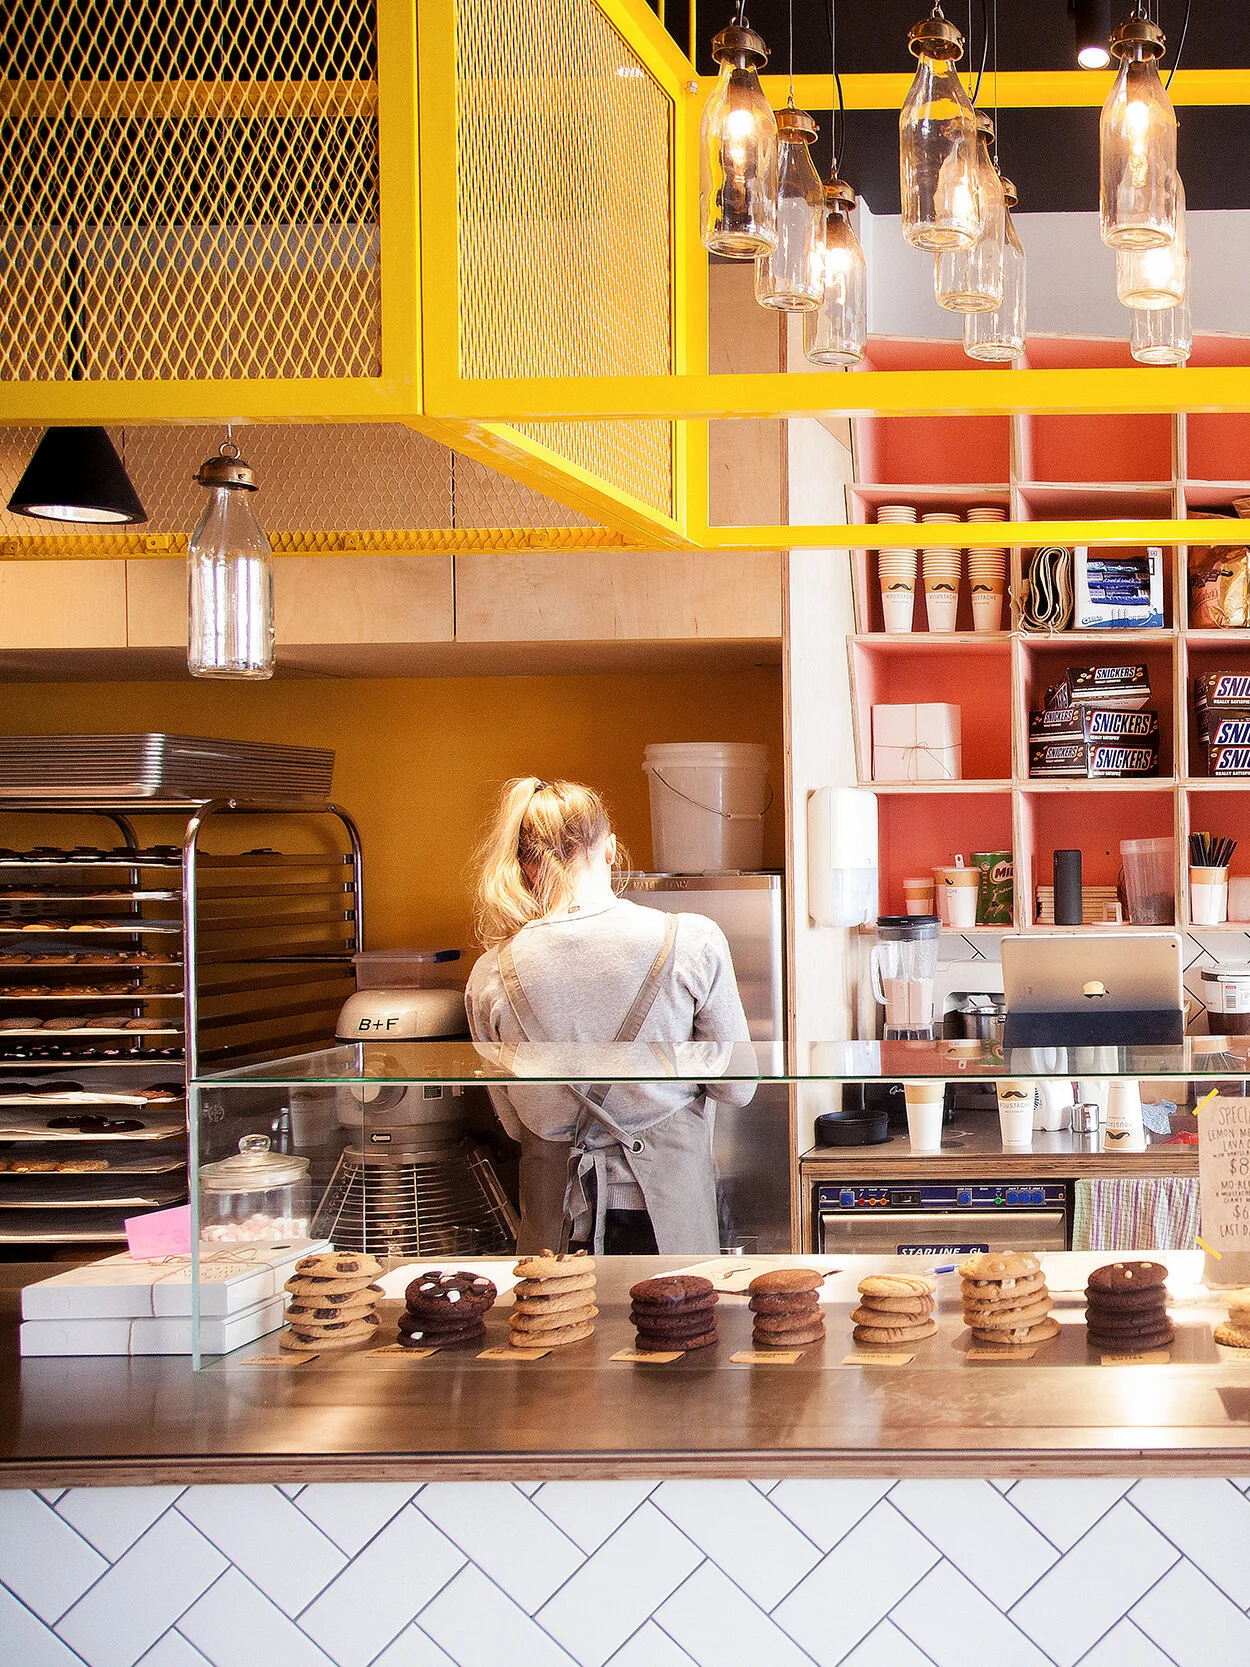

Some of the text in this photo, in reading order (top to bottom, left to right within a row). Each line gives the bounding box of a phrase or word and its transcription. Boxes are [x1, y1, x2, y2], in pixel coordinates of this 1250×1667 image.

[1096, 667, 1136, 679] SNICKERS
[1044, 710, 1073, 723] SNICKERS
[1092, 713, 1150, 734] SNICKERS
[1046, 747, 1077, 758] SNICKERS
[1095, 748, 1151, 769] SNICKERS
[358, 1018, 399, 1031] B+F
[1207, 1128, 1236, 1142] LEMON
[1223, 1140, 1245, 1152] LAVA
[1220, 1224, 1239, 1238] LAST
